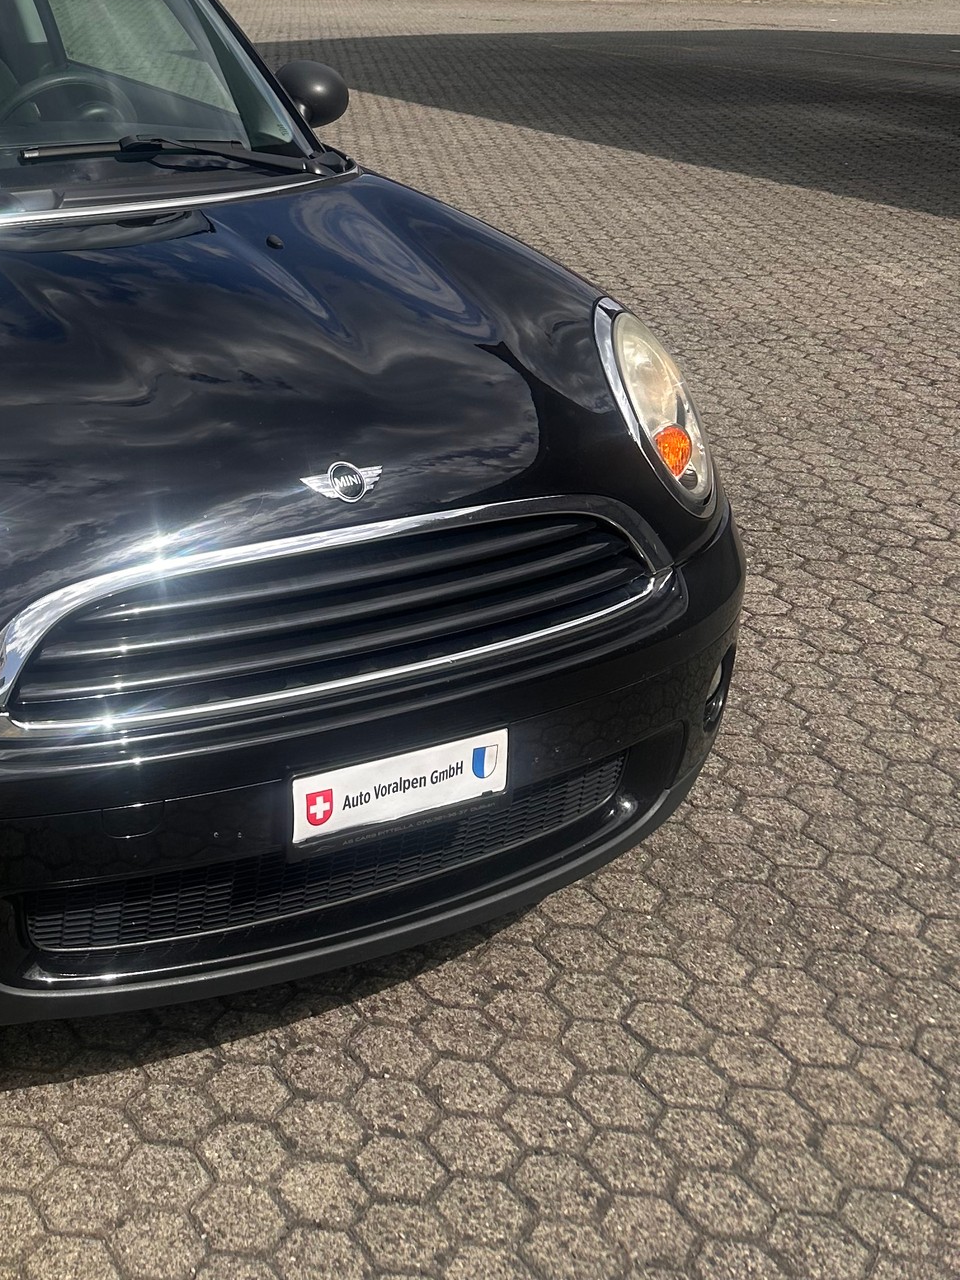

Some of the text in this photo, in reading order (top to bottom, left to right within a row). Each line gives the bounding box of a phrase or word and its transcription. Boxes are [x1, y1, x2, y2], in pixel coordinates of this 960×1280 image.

[334, 474, 361, 489] MINI
[342, 761, 464, 811] Auto Voralpen GmbH
